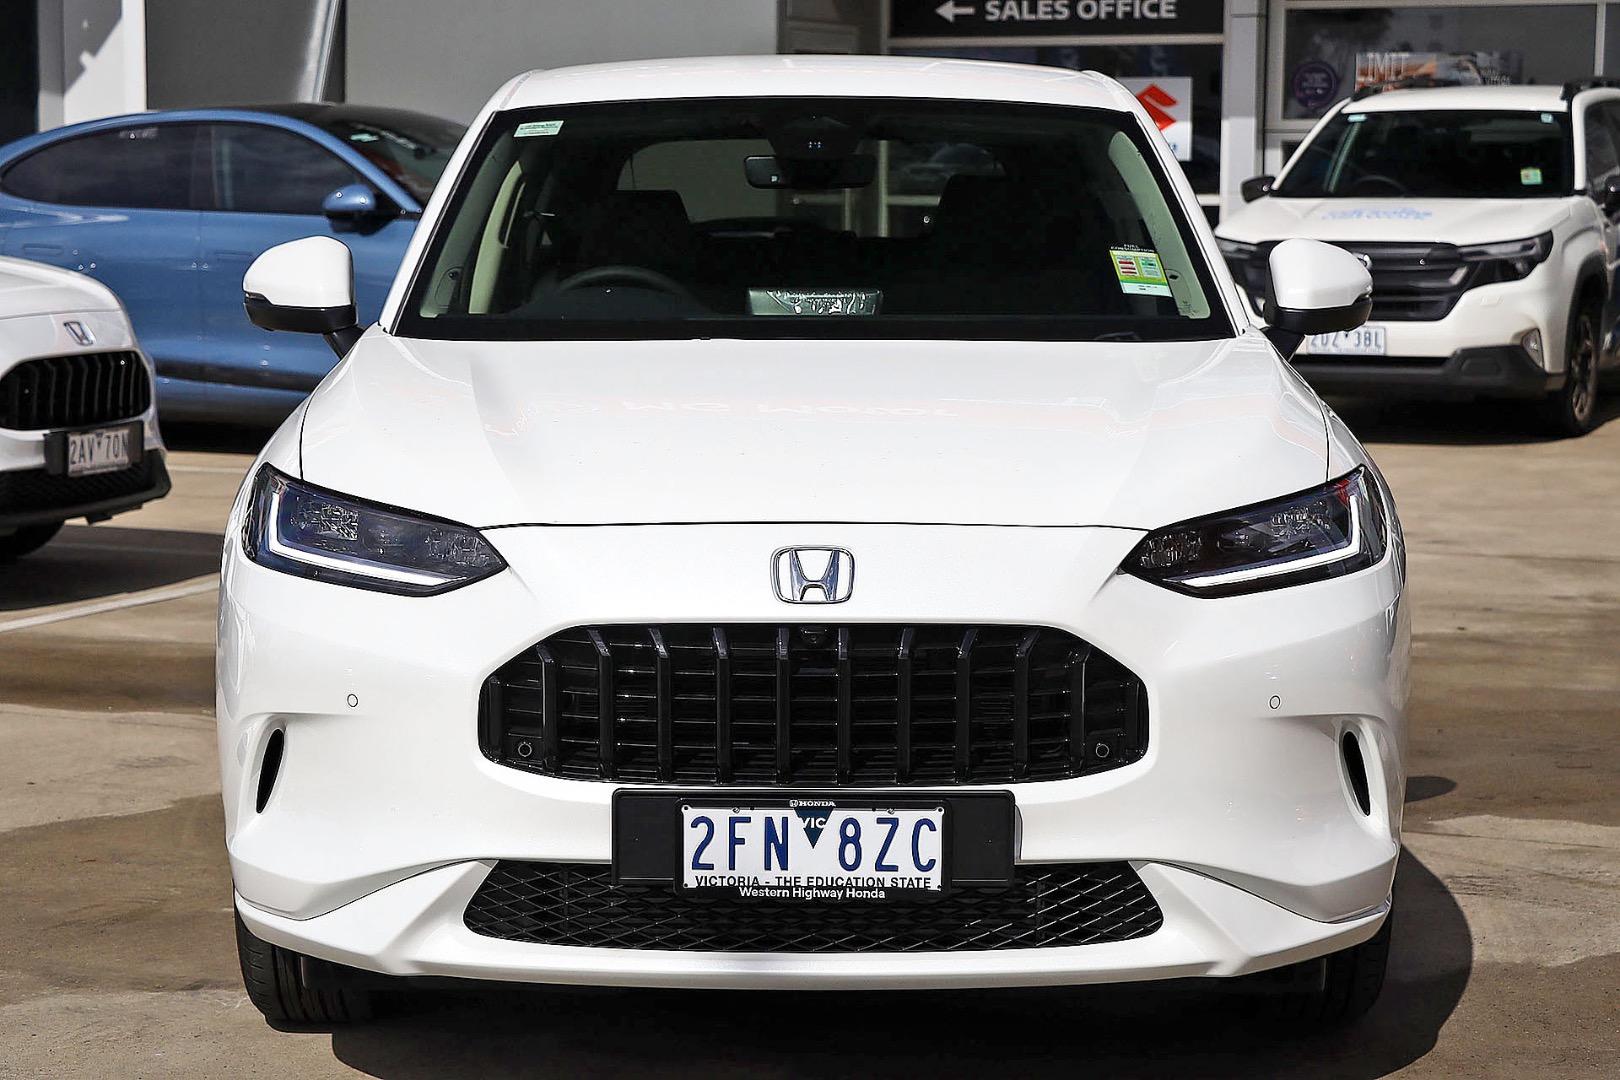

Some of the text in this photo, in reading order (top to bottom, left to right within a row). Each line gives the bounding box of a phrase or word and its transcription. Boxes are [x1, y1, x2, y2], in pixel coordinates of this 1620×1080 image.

[985, 0, 1177, 20] SALES OFFICE
[798, 800, 836, 808] HONDA
[801, 816, 827, 829] VIC
[690, 815, 937, 872] 2FN 8ZC
[695, 875, 760, 887] VICTORIA
[775, 876, 801, 887] THE
[807, 876, 886, 888] EDUCATION
[890, 877, 931, 889] STATE
[738, 886, 886, 900] Western Highway Honda
